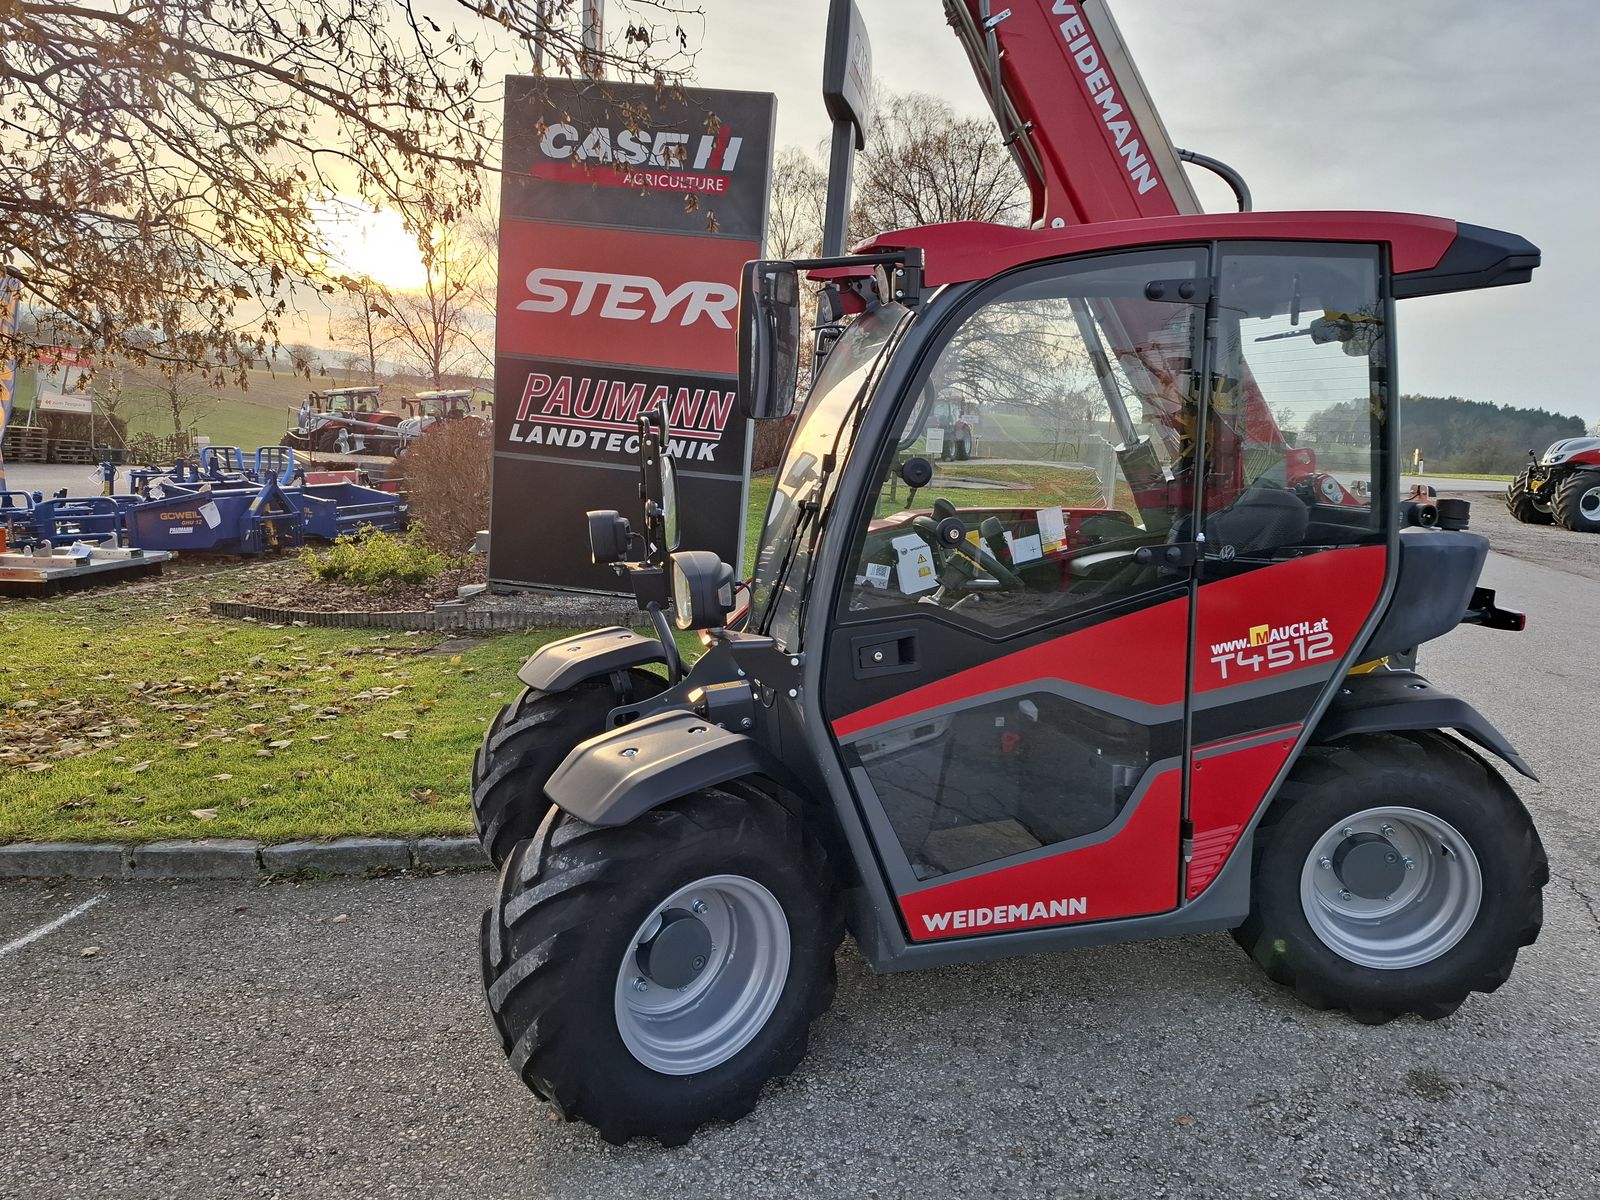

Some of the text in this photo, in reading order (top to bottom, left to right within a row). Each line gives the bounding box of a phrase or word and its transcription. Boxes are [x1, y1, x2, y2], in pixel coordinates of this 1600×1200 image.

[539, 123, 689, 168] CASE
[623, 172, 724, 192] AGRICULTURE
[516, 267, 738, 329] STEYR
[515, 372, 736, 431] PAUMANN
[508, 423, 720, 462] LANDTECNIK
[1210, 632, 1334, 679] T4512
[921, 896, 1087, 932] WEIDEMANN
